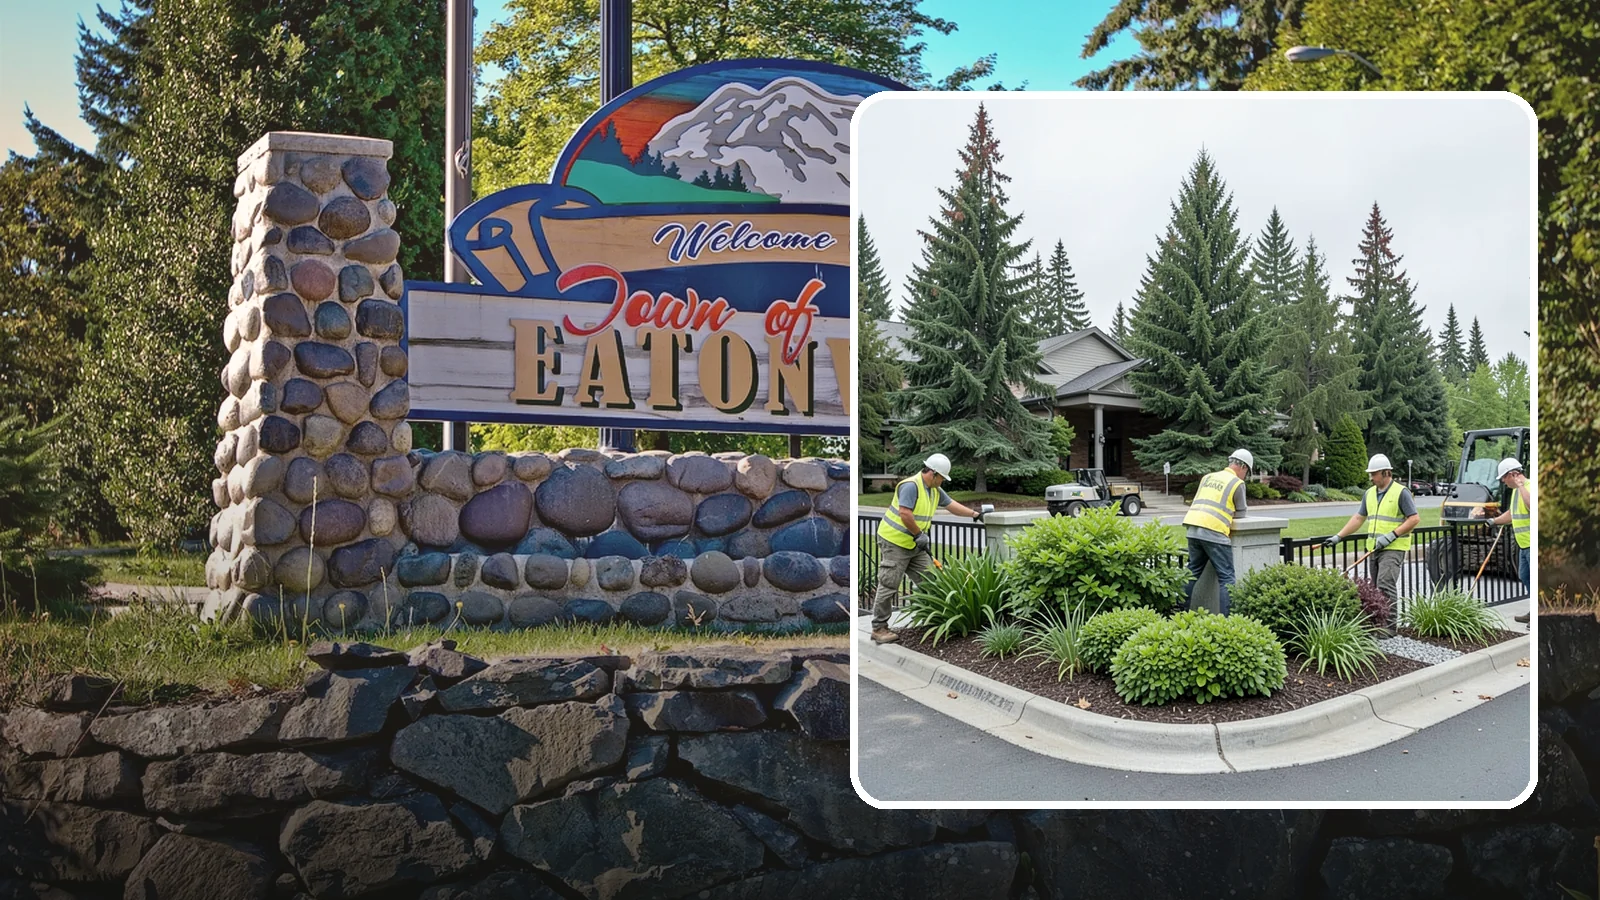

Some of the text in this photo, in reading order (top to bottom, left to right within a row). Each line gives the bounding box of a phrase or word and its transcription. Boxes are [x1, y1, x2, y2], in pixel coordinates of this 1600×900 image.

[653, 220, 838, 264] Welcome
[556, 263, 826, 366] Town of
